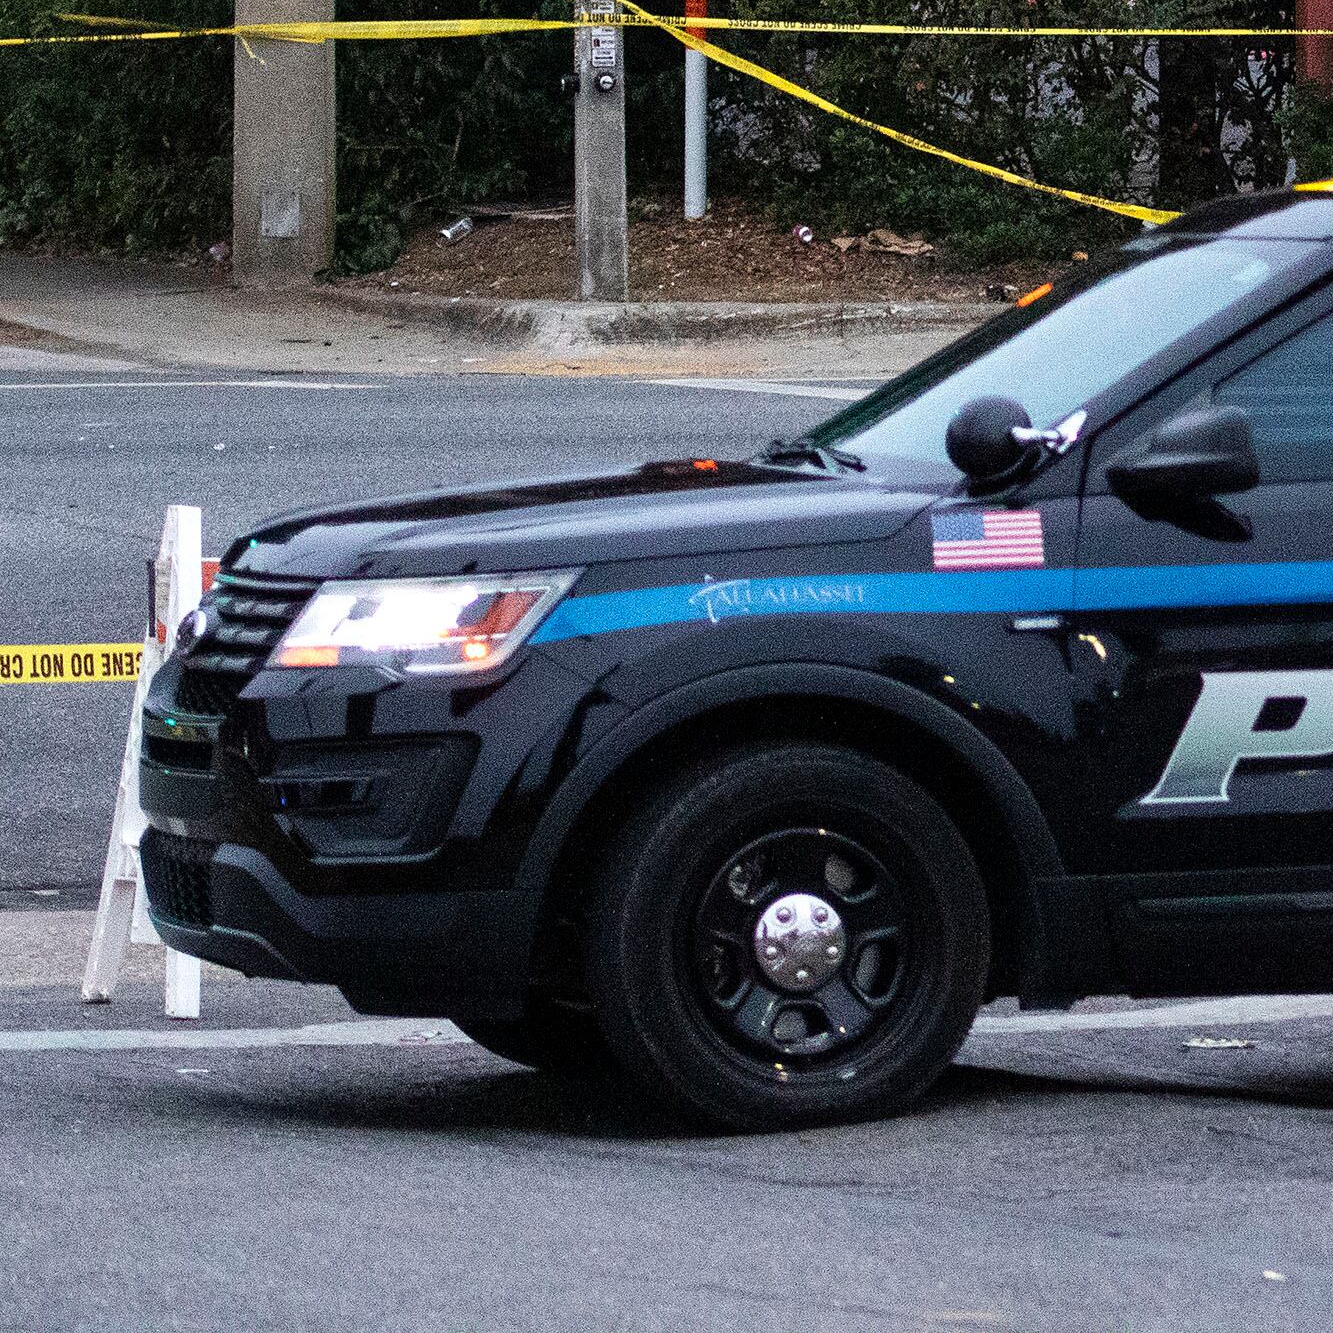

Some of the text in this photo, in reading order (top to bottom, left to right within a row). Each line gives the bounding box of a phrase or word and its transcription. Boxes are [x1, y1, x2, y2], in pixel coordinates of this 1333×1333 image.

[30, 653, 64, 678] NOT
[71, 653, 95, 677] DO
[101, 652, 143, 677] CENE
